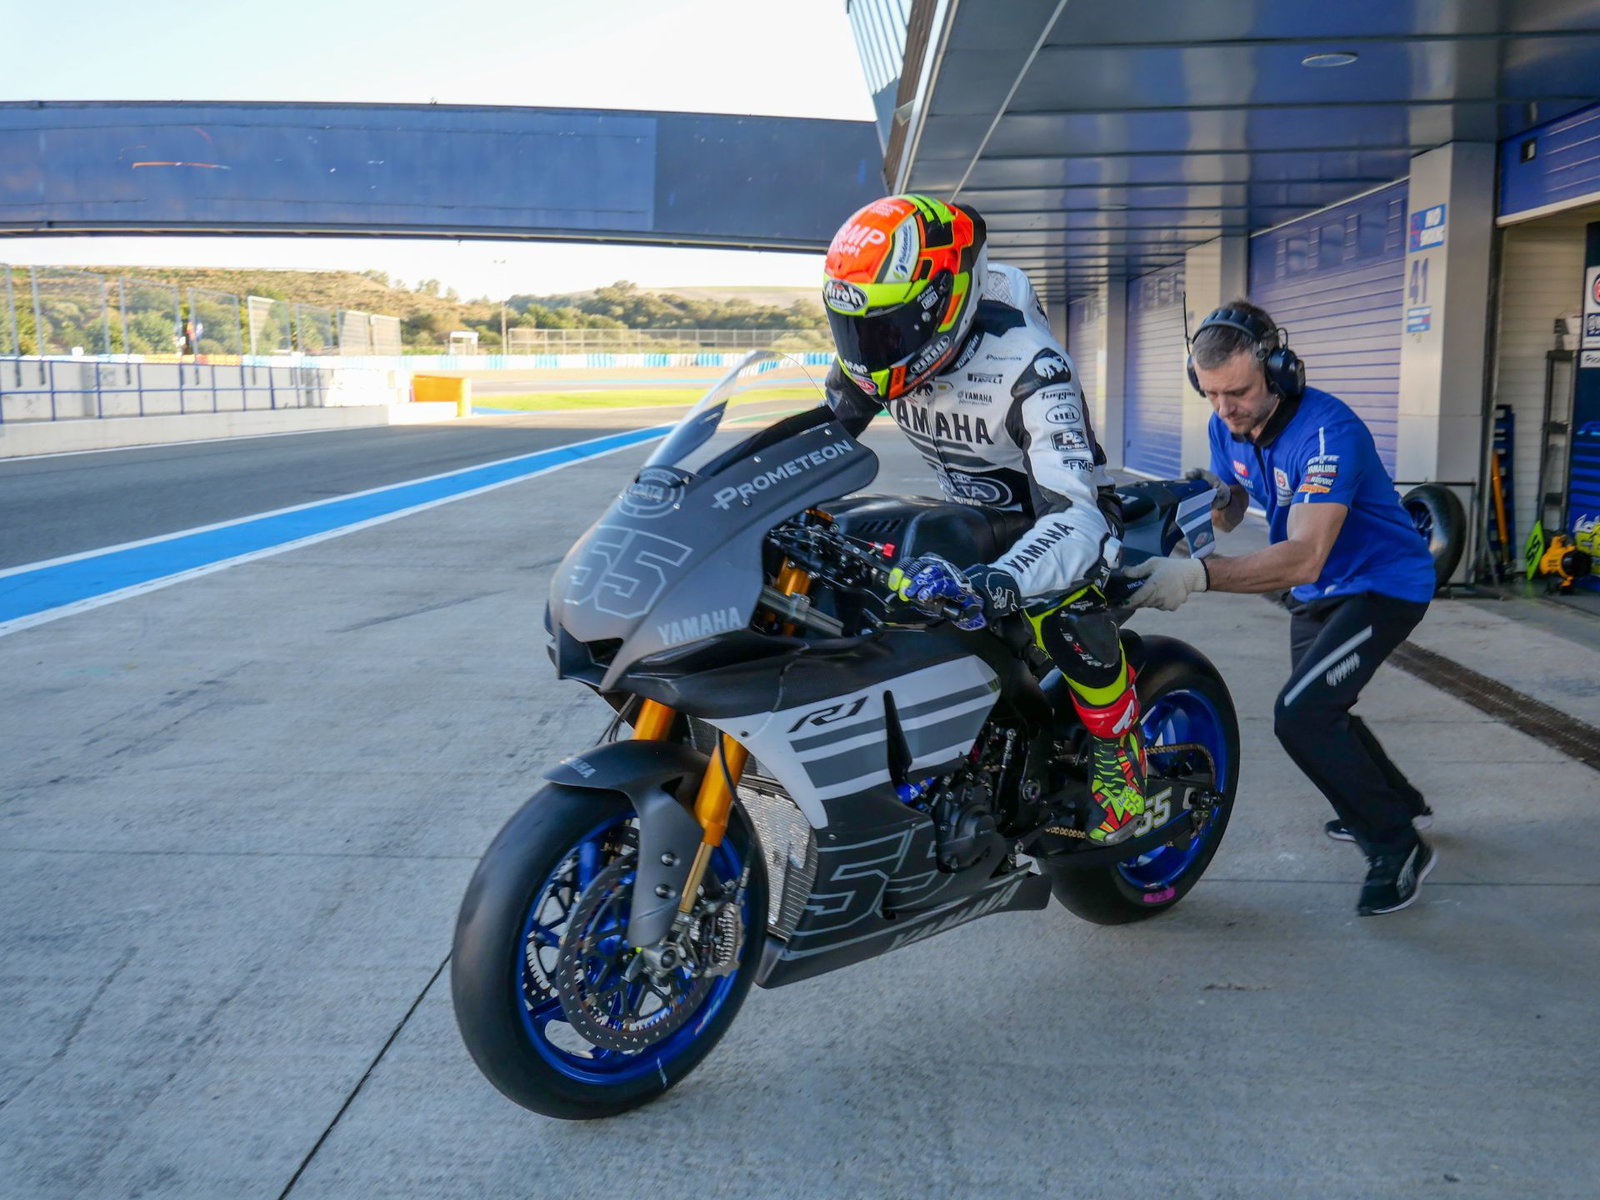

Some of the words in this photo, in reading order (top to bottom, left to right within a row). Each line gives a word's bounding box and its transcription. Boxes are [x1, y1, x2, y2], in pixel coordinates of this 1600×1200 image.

[824, 281, 864, 306] Airoh
[1409, 258, 1429, 304] 41
[965, 391, 992, 404] YAMAHA
[1054, 411, 1077, 421] HEL
[711, 439, 854, 511] PROMETEON
[1004, 521, 1075, 574] YAMAHA
[657, 607, 742, 645] YAMAHA
[787, 696, 868, 733] R1
